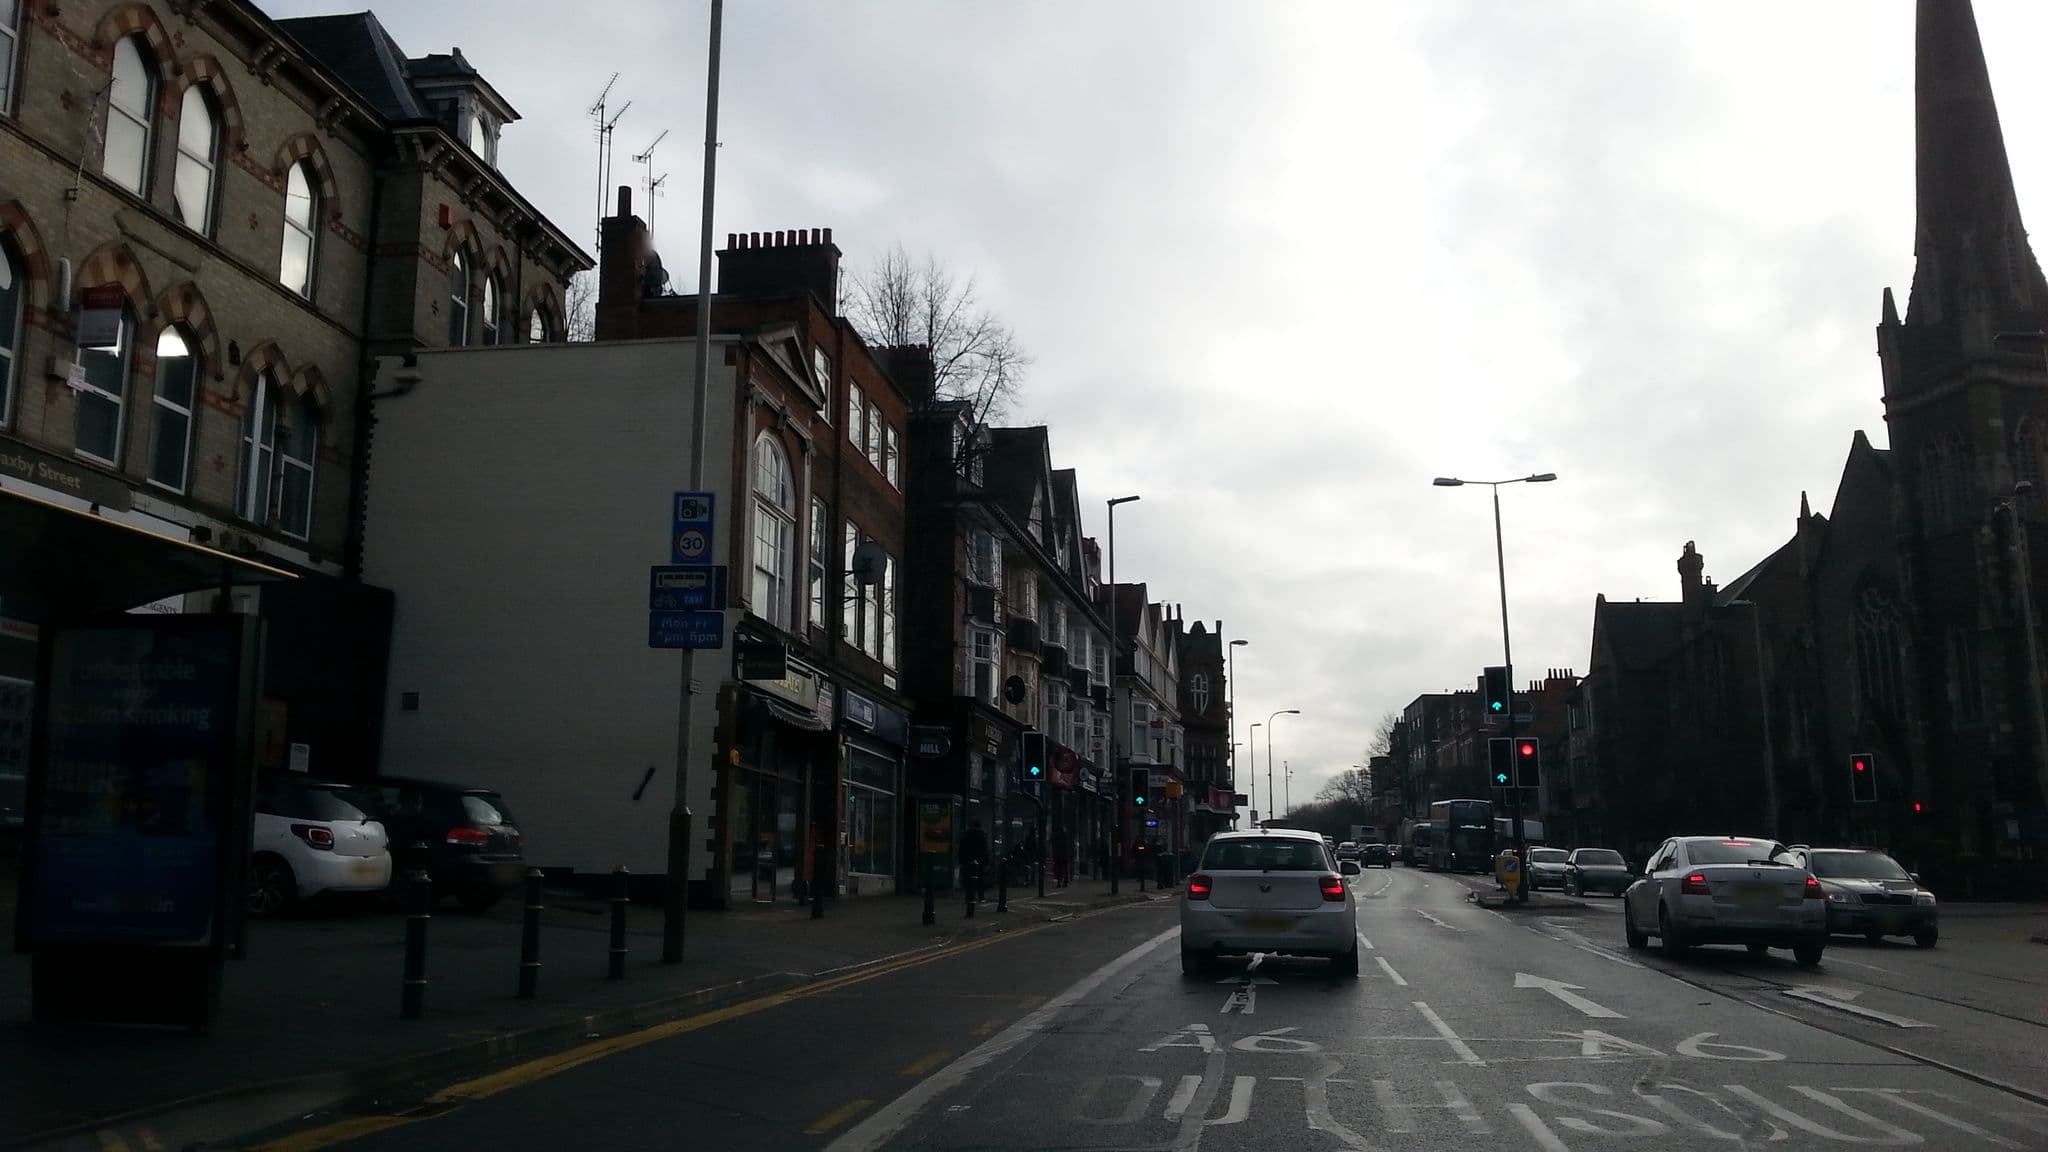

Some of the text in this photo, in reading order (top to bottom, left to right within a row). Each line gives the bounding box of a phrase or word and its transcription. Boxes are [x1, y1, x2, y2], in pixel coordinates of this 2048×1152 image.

[38, 462, 81, 489] Street
[682, 537, 703, 550] 30
[1137, 1023, 1322, 1054] A6
[1551, 1029, 1786, 1062] A6
